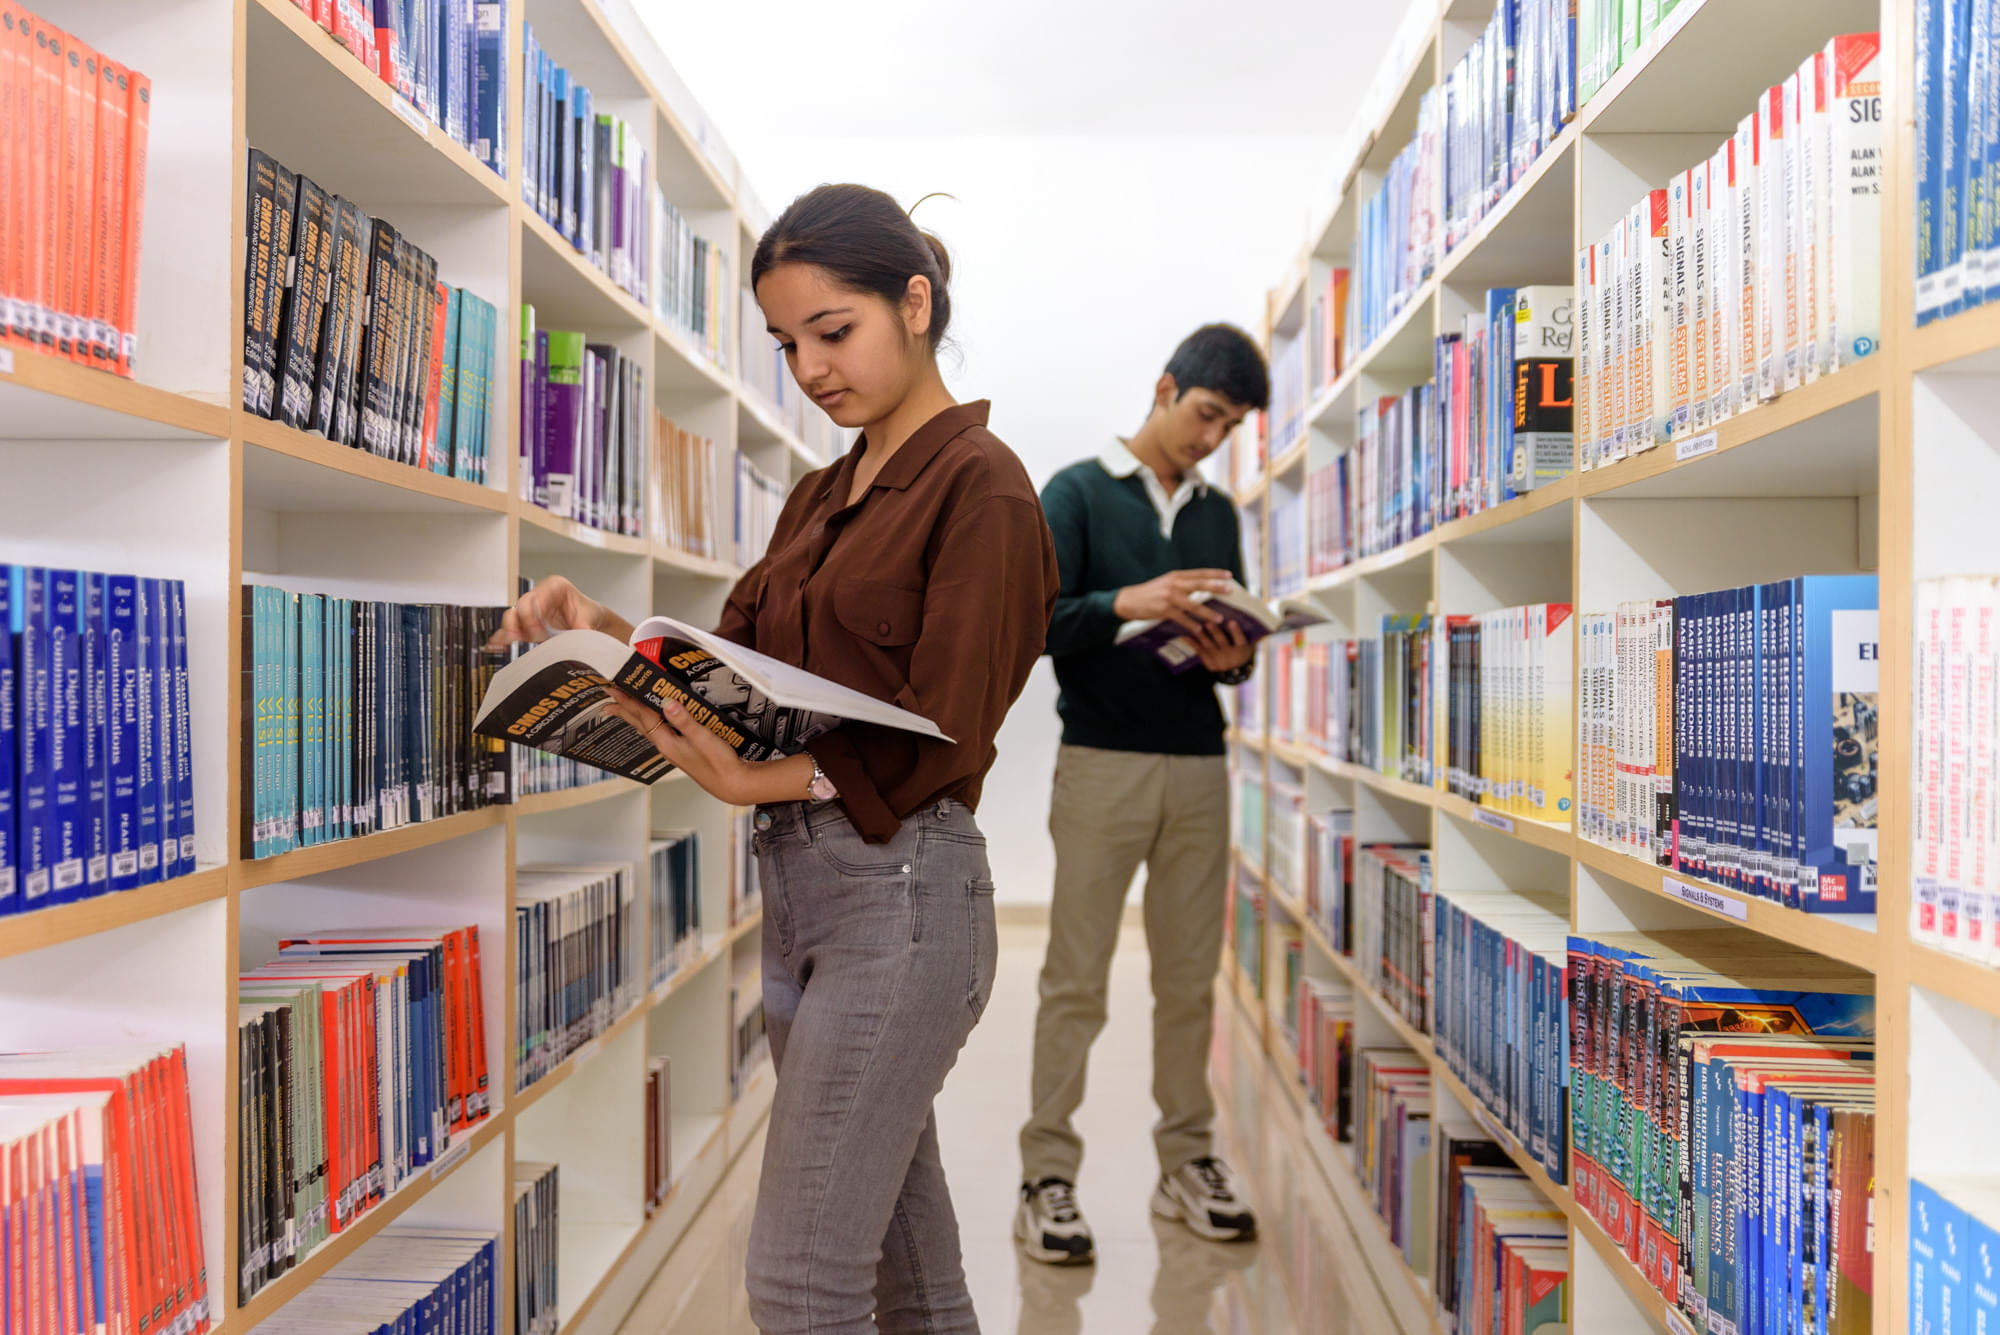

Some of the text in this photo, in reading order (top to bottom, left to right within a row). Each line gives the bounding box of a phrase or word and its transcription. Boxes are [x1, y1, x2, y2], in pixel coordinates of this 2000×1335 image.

[1851, 149, 1875, 160] ALAN
[1851, 166, 1875, 177] ALAN
[252, 198, 262, 231] CIRCUITS
[1743, 187, 1752, 255] SIGNALS
[249, 246, 258, 278] SYSTEMS
[252, 197, 273, 332] CMOS VLSI Design
[271, 208, 291, 340] CMOS VLSI Design
[297, 221, 319, 348] CMOS VLSI Design
[341, 239, 353, 281] CMOS
[379, 260, 391, 300] CMOS
[1696, 228, 1704, 290] SIGNALS
[1743, 259, 1751, 285] AND
[310, 231, 332, 353] CMOS VLSI Design
[377, 300, 387, 331] VLSI
[1603, 287, 1611, 341] SIGNALS
[1675, 235, 1688, 395] SIGNALS AND SYSTEMS
[1634, 262, 1644, 412] SIGNALS AND SYSTEMS
[1696, 319, 1706, 391] SYSTEMS
[1515, 362, 1529, 428] Linux
[1603, 366, 1612, 428] SYSTEMS
[66, 669, 79, 726] Digital
[111, 628, 122, 766] Communications
[123, 669, 136, 723] Digital
[258, 697, 266, 747] VLSI
[275, 696, 283, 745] VLSI
[507, 697, 561, 736] CMOS
[529, 706, 565, 736] CIRCUITS
[562, 695, 580, 711] AND
[652, 677, 688, 707] CMOS
[685, 697, 709, 726] VLSI
[704, 715, 745, 749] Design
[1681, 885, 1724, 910] SIGNALS SYSTEMS
[1822, 876, 1836, 884] Mc
[1822, 884, 1844, 893] Graw
[1822, 891, 1838, 900] Hill
[1575, 960, 1587, 1111] Basic Electronics
[1665, 1008, 1679, 1185] Basic Electronics
[1679, 1055, 1689, 1097] Basic
[1679, 1101, 1691, 1184] Electronics
[1752, 1116, 1760, 1216] PRINCIPLES OF
[1715, 1152, 1723, 1256] ELECTRONICS
[1728, 1160, 1736, 1265] ELECTRONICS
[1829, 1188, 1842, 1319] Electronics Engineering
